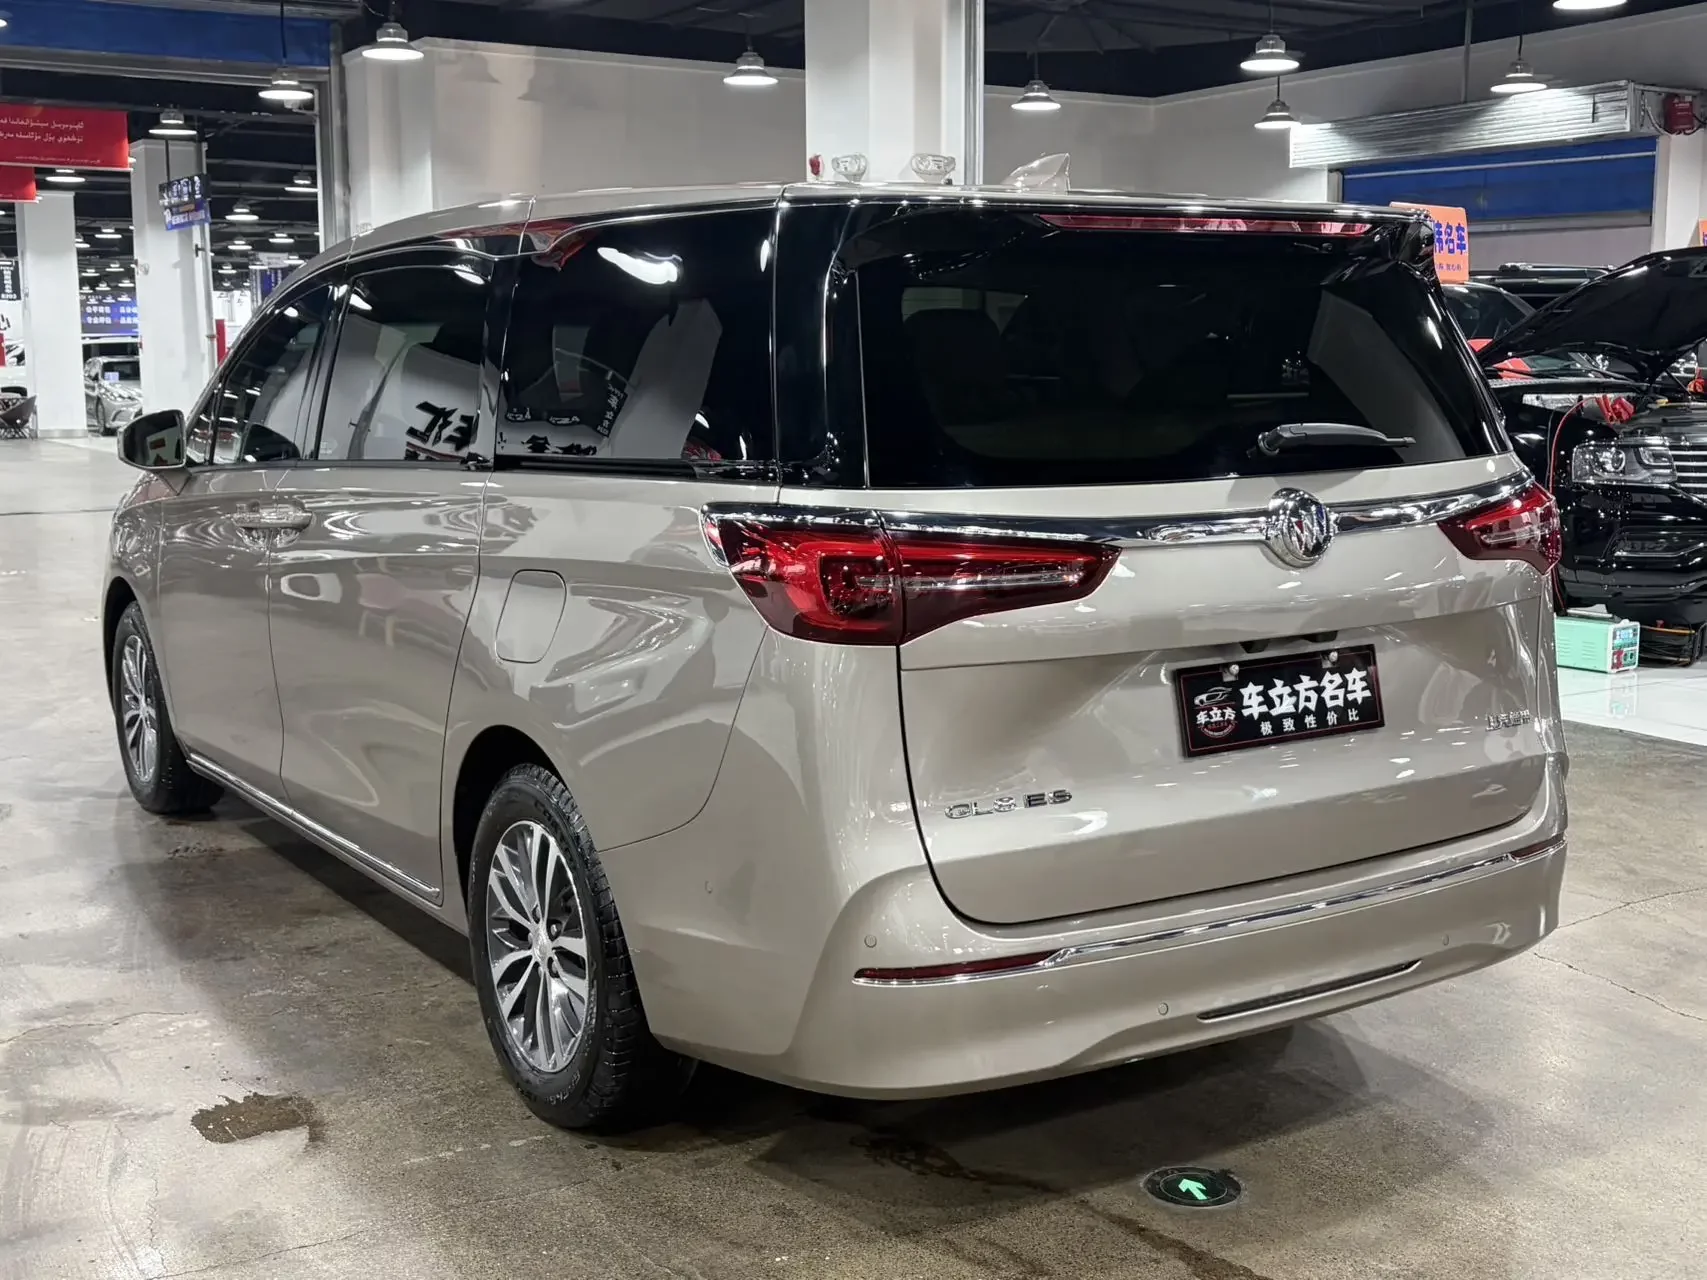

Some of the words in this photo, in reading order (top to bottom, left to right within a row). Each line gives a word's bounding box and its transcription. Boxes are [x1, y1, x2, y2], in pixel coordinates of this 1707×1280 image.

[1239, 667, 1372, 721] 车立方名车
[1196, 706, 1237, 725] 车立方
[1259, 708, 1360, 737] 极致性价比
[944, 796, 1017, 819] GL8
[1023, 789, 1073, 809] ES
